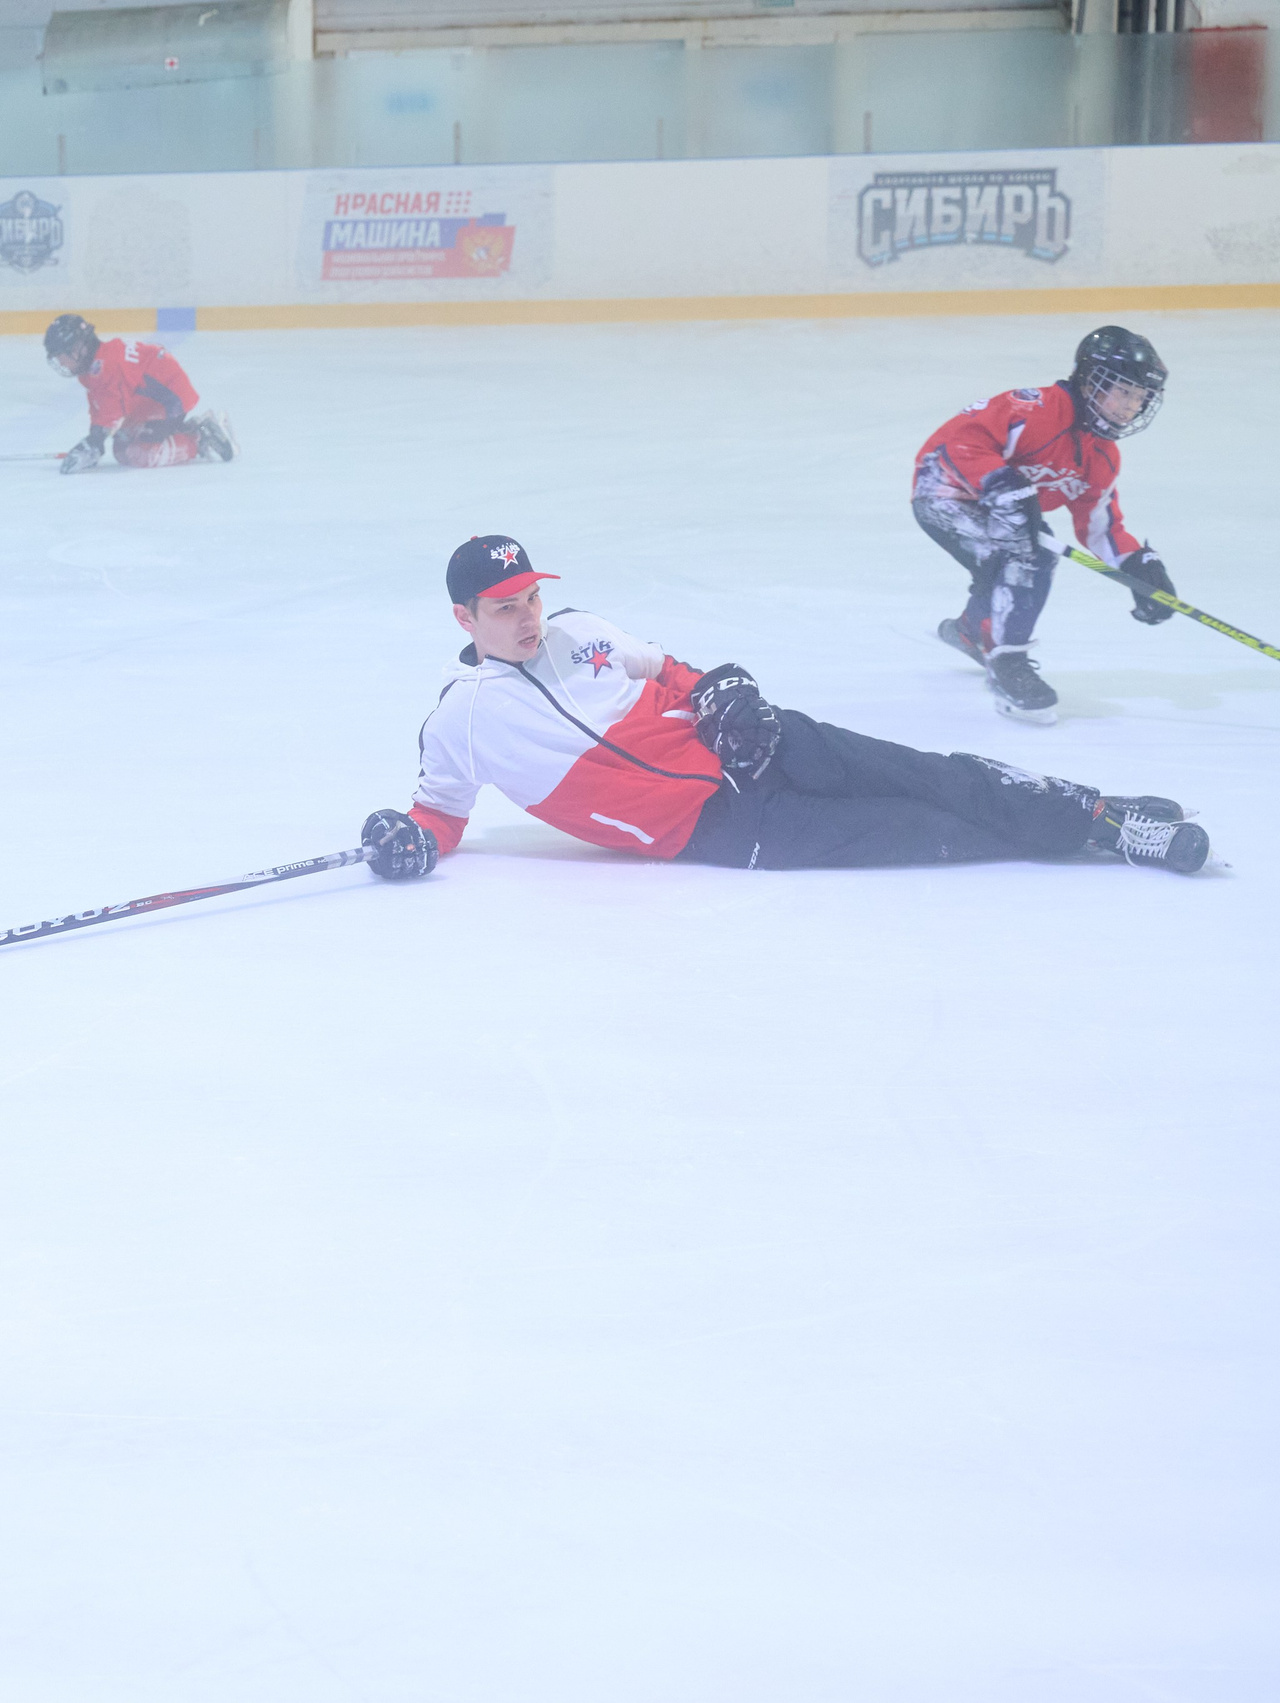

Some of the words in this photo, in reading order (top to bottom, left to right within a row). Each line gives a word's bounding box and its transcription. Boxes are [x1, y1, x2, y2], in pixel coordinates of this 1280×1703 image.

[334, 191, 440, 215] КРАСНАЯ
[330, 221, 440, 248] МАШИНА
[861, 184, 1067, 262] СИБИРЬ
[698, 677, 759, 708] CCM
[276, 859, 314, 875] prime
